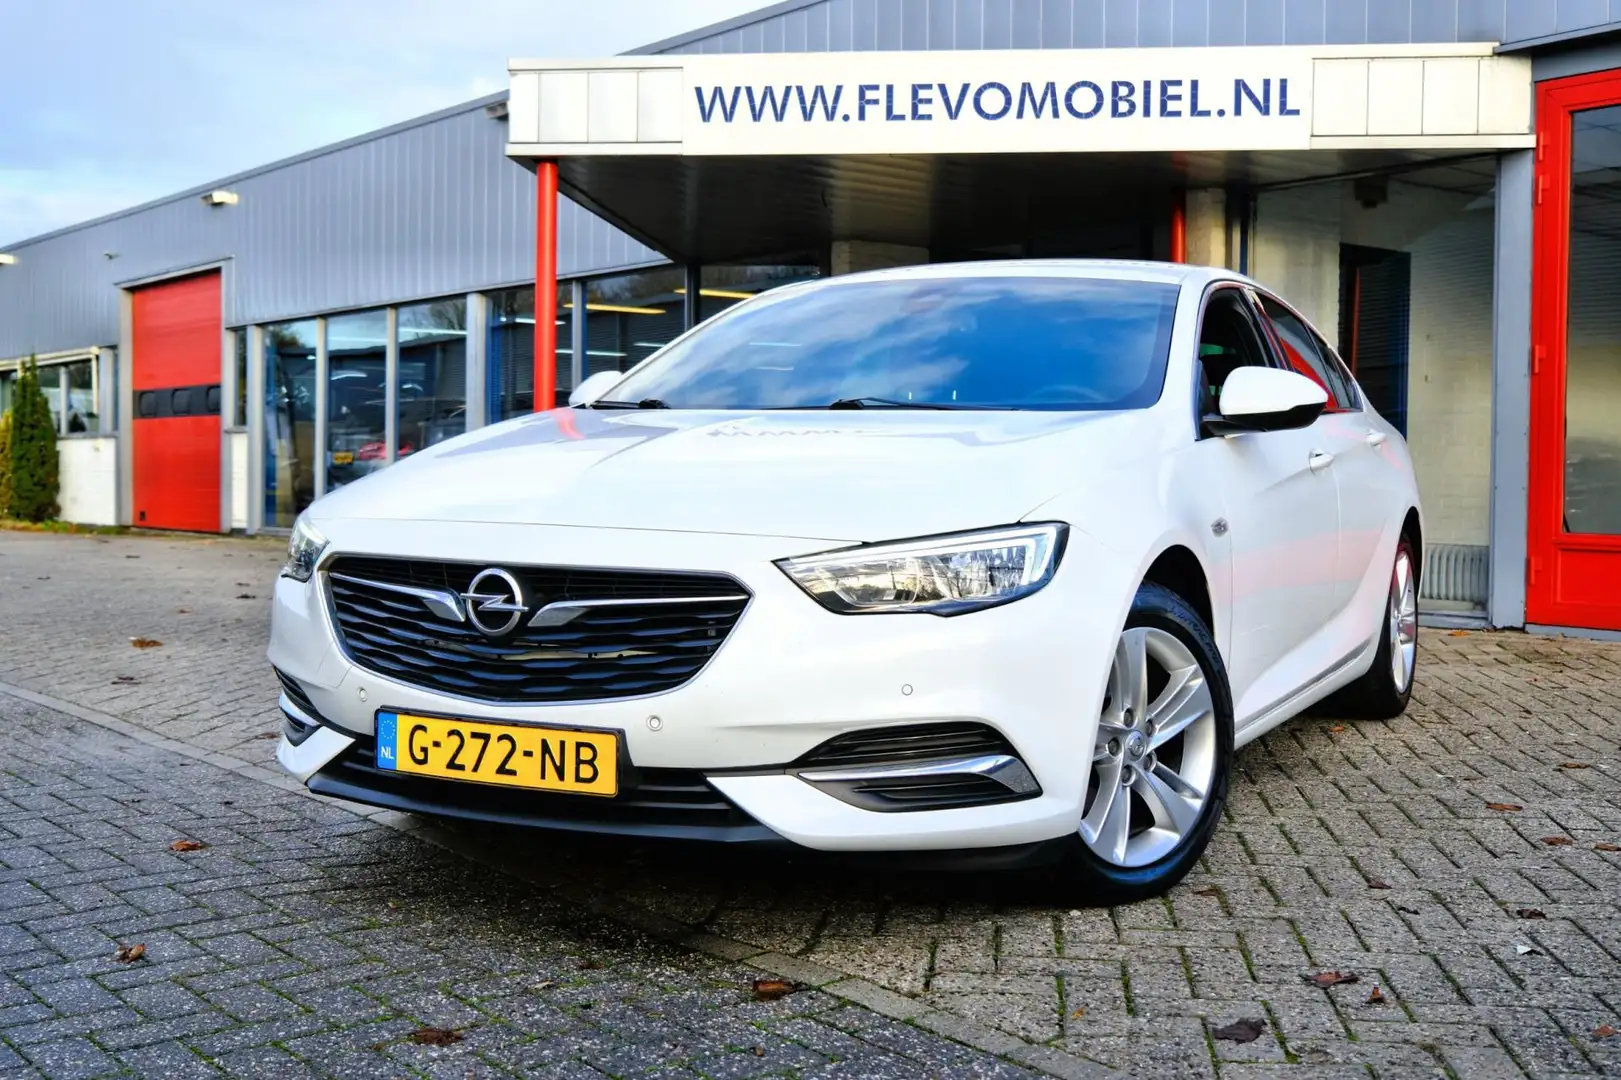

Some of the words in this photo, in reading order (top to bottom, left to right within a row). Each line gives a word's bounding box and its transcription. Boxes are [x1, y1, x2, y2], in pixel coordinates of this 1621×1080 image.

[695, 78, 1300, 122] WWW.FLEVOMOBIEL.NL
[381, 745, 394, 760] NL
[408, 724, 599, 784] G-272-NB
